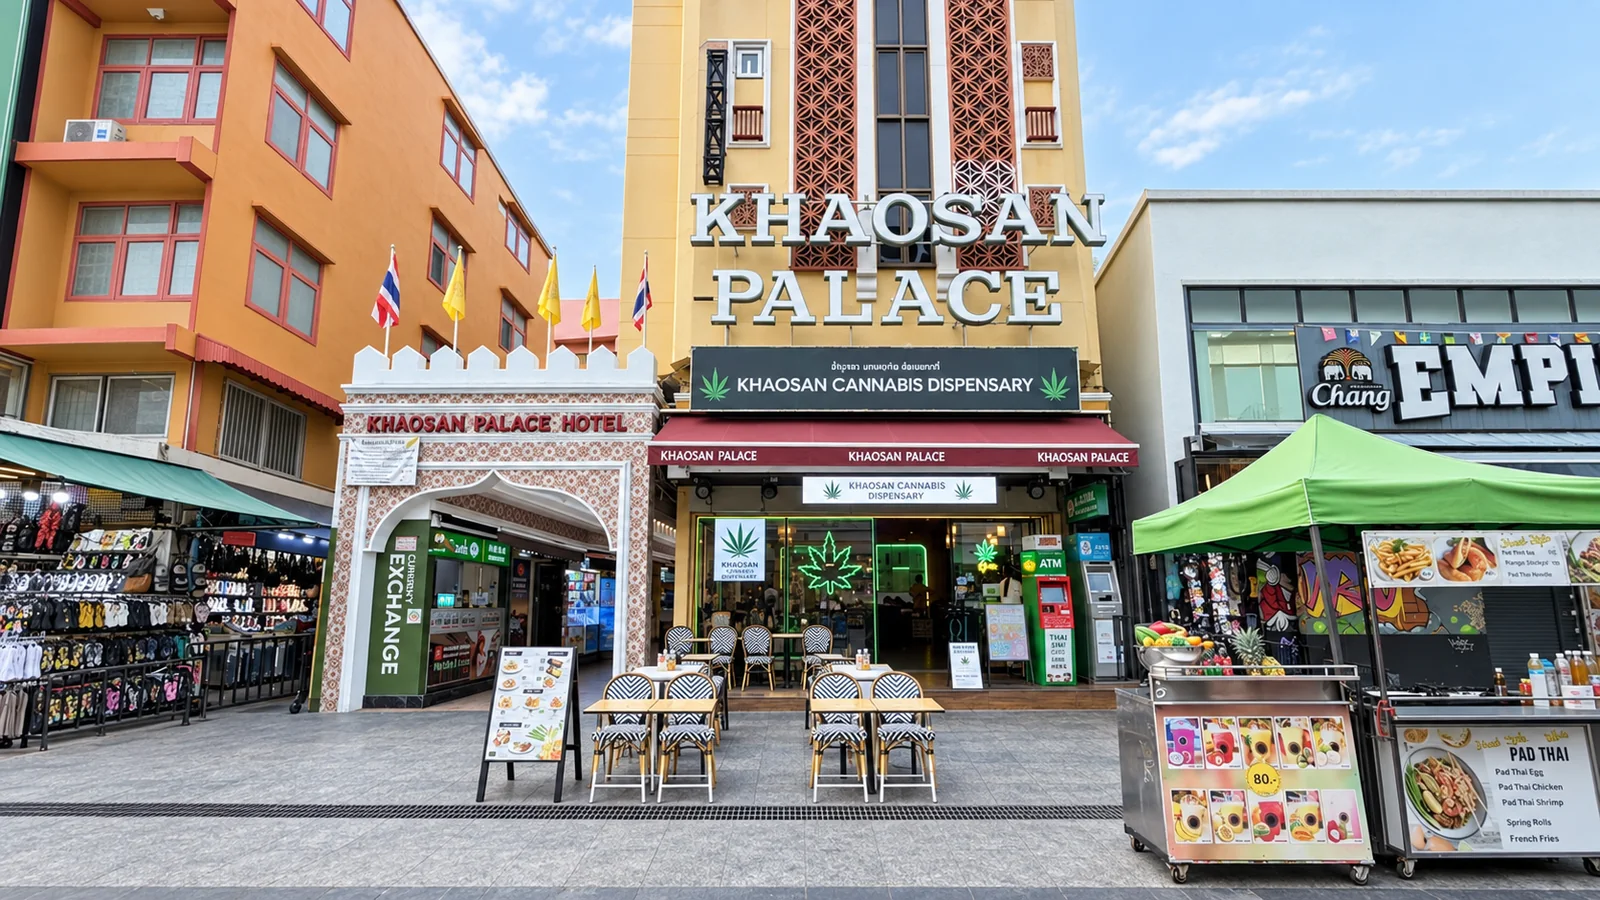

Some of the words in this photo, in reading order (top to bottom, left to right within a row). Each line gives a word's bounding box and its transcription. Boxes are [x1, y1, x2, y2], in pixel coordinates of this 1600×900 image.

[690, 192, 1107, 247] KHAOSAN
[710, 269, 1063, 326] PALACE
[737, 377, 828, 392] KHAOSAN
[831, 377, 924, 392] CANNABIS
[928, 377, 1034, 392] DISPENSARY
[1386, 343, 1600, 422] EMPI
[1310, 382, 1391, 412] Chang
[367, 415, 466, 433] KHAOSAN
[474, 415, 551, 433] PALACE
[562, 415, 628, 433] HOTEL
[660, 450, 714, 462] KHAOSAN
[718, 450, 757, 462] PALACE
[848, 451, 902, 462] KHAOSAN
[905, 451, 945, 462] PALACE
[1037, 452, 1088, 463] KHAOSAN
[1091, 452, 1129, 463] PALACE
[848, 481, 894, 491] KHAOSAN
[897, 481, 946, 491] CANNABIS
[868, 491, 924, 501] DISPENSARY
[1039, 559, 1062, 568] ATM
[381, 554, 405, 675] EXCHANGE
[1509, 746, 1536, 762] PAD
[1538, 746, 1570, 762] THAI
[1495, 768, 1510, 776] Pad
[1511, 768, 1528, 776] Thai
[1529, 768, 1544, 777] Egg
[1253, 773, 1277, 785] 80.-
[1498, 783, 1513, 791] Pad
[1514, 783, 1532, 791] Thai
[1532, 783, 1563, 791] Chicken
[1536, 799, 1564, 807] Shrimp
[1506, 818, 1532, 828] Spring
[1532, 818, 1552, 827] Rolls
[1509, 834, 1538, 843] French
[1539, 834, 1560, 843] Fries
